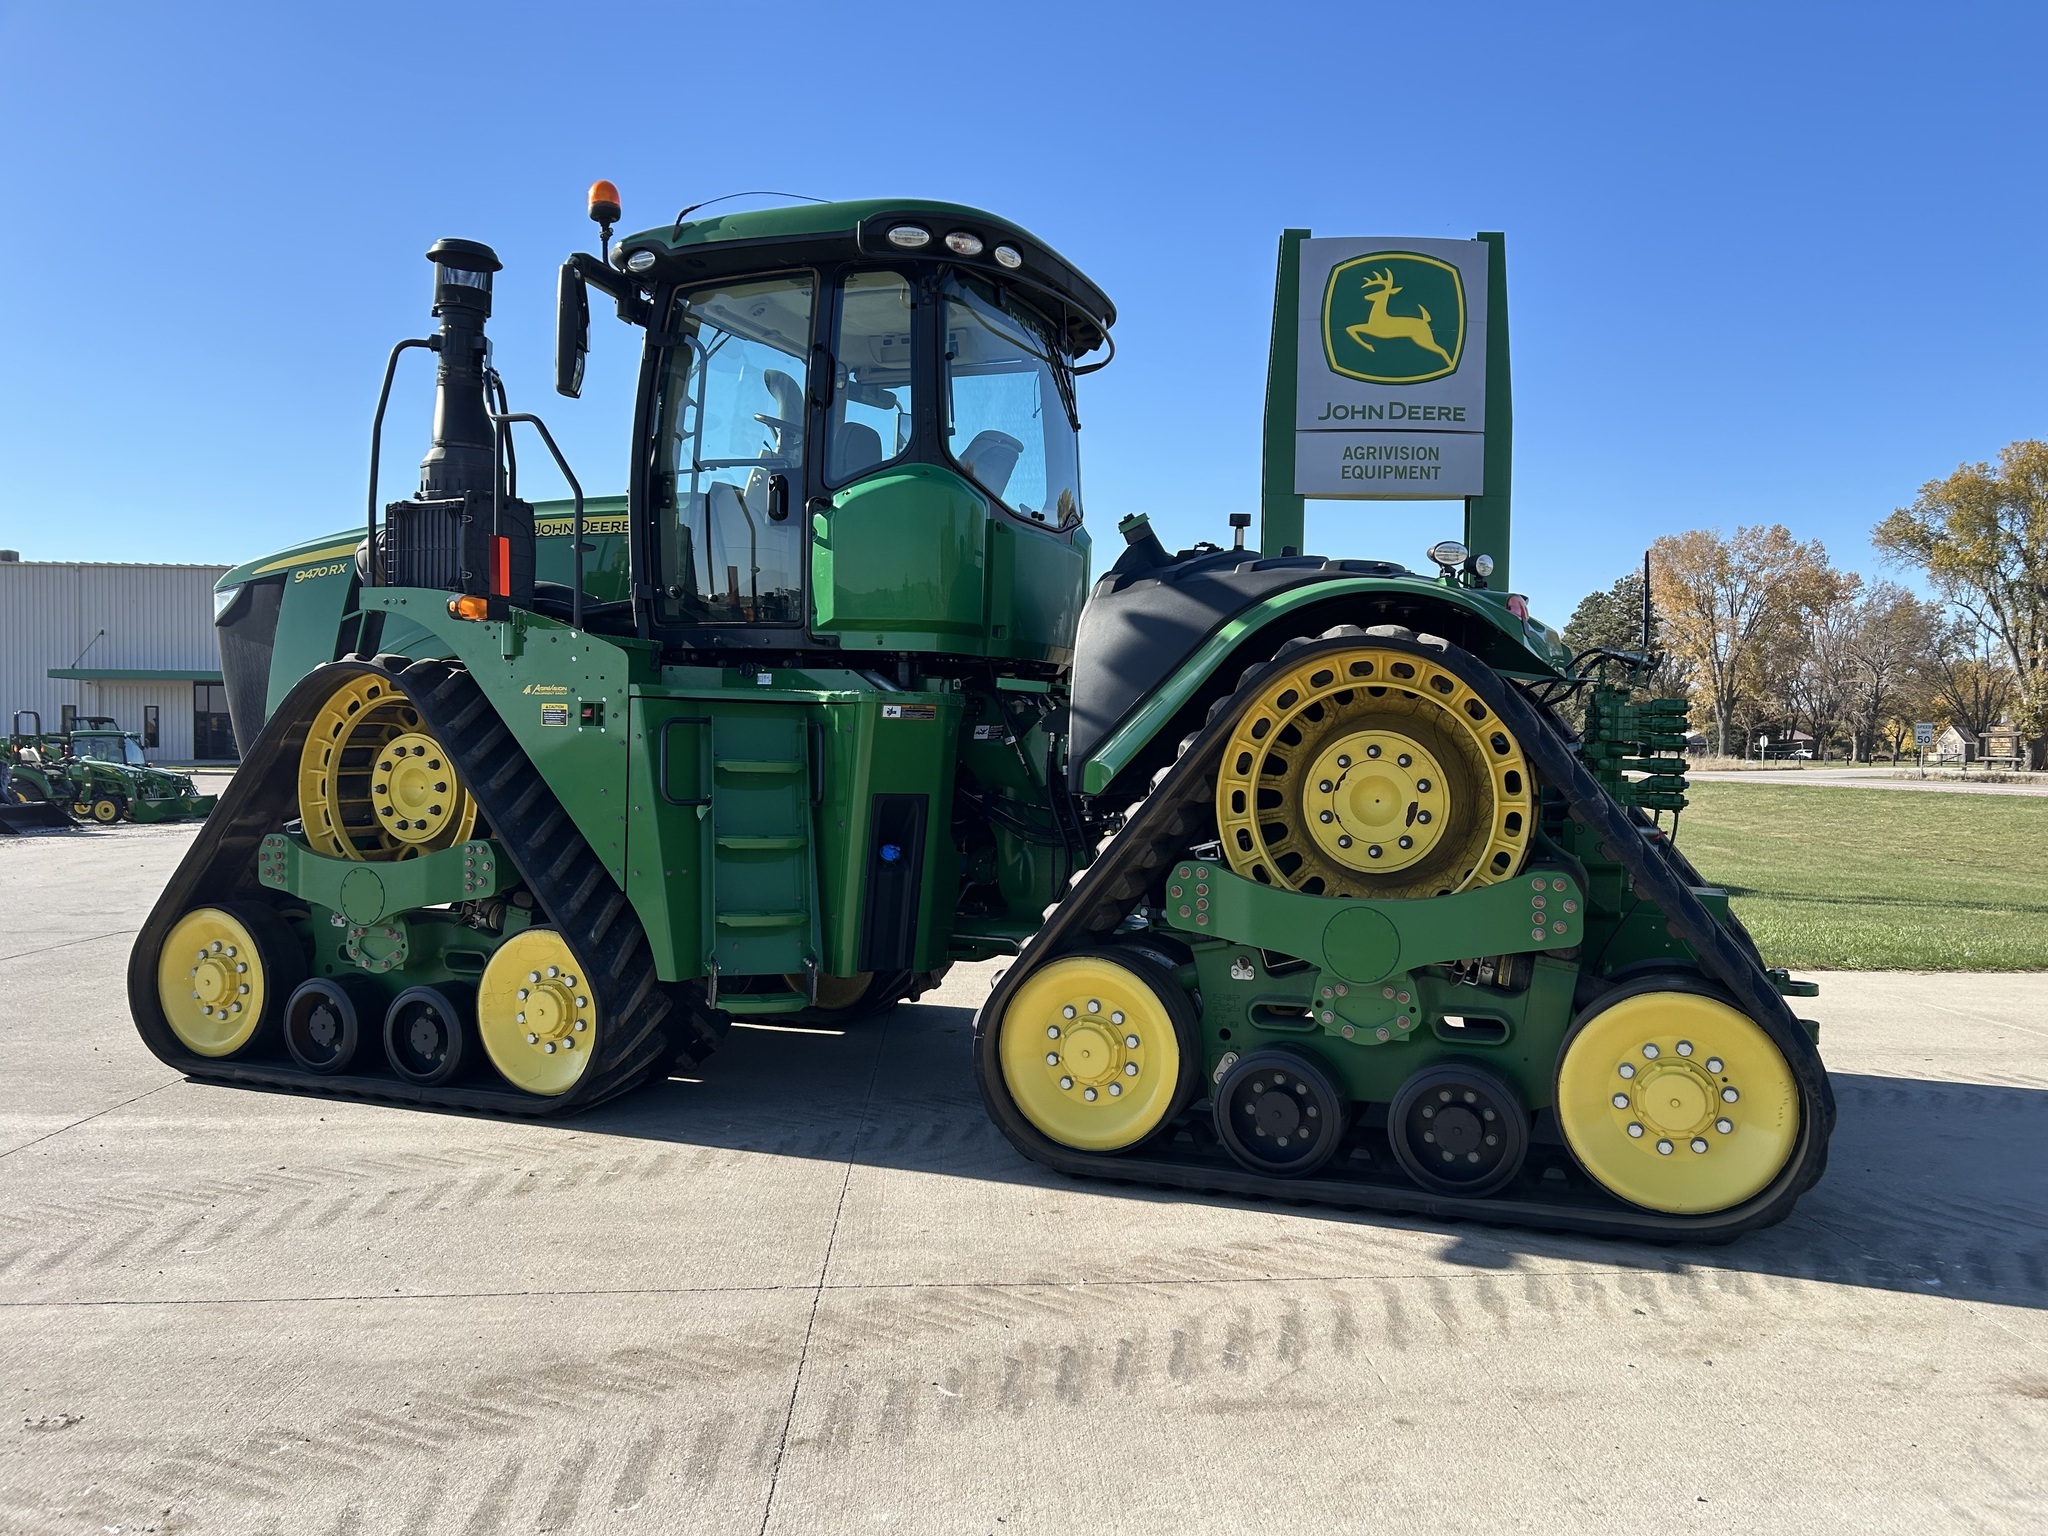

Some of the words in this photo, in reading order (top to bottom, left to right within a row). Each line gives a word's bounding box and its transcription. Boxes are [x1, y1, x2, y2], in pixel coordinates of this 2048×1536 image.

[1317, 402, 1384, 421] JOHN
[1389, 402, 1466, 422] DEERE
[1342, 446, 1440, 461] AGRIVISION
[1341, 465, 1441, 480] EQUIPMENT
[535, 522, 574, 535] JOHN
[294, 566, 328, 583] 9470
[328, 563, 347, 576] RX
[1917, 735, 1931, 744] 50
